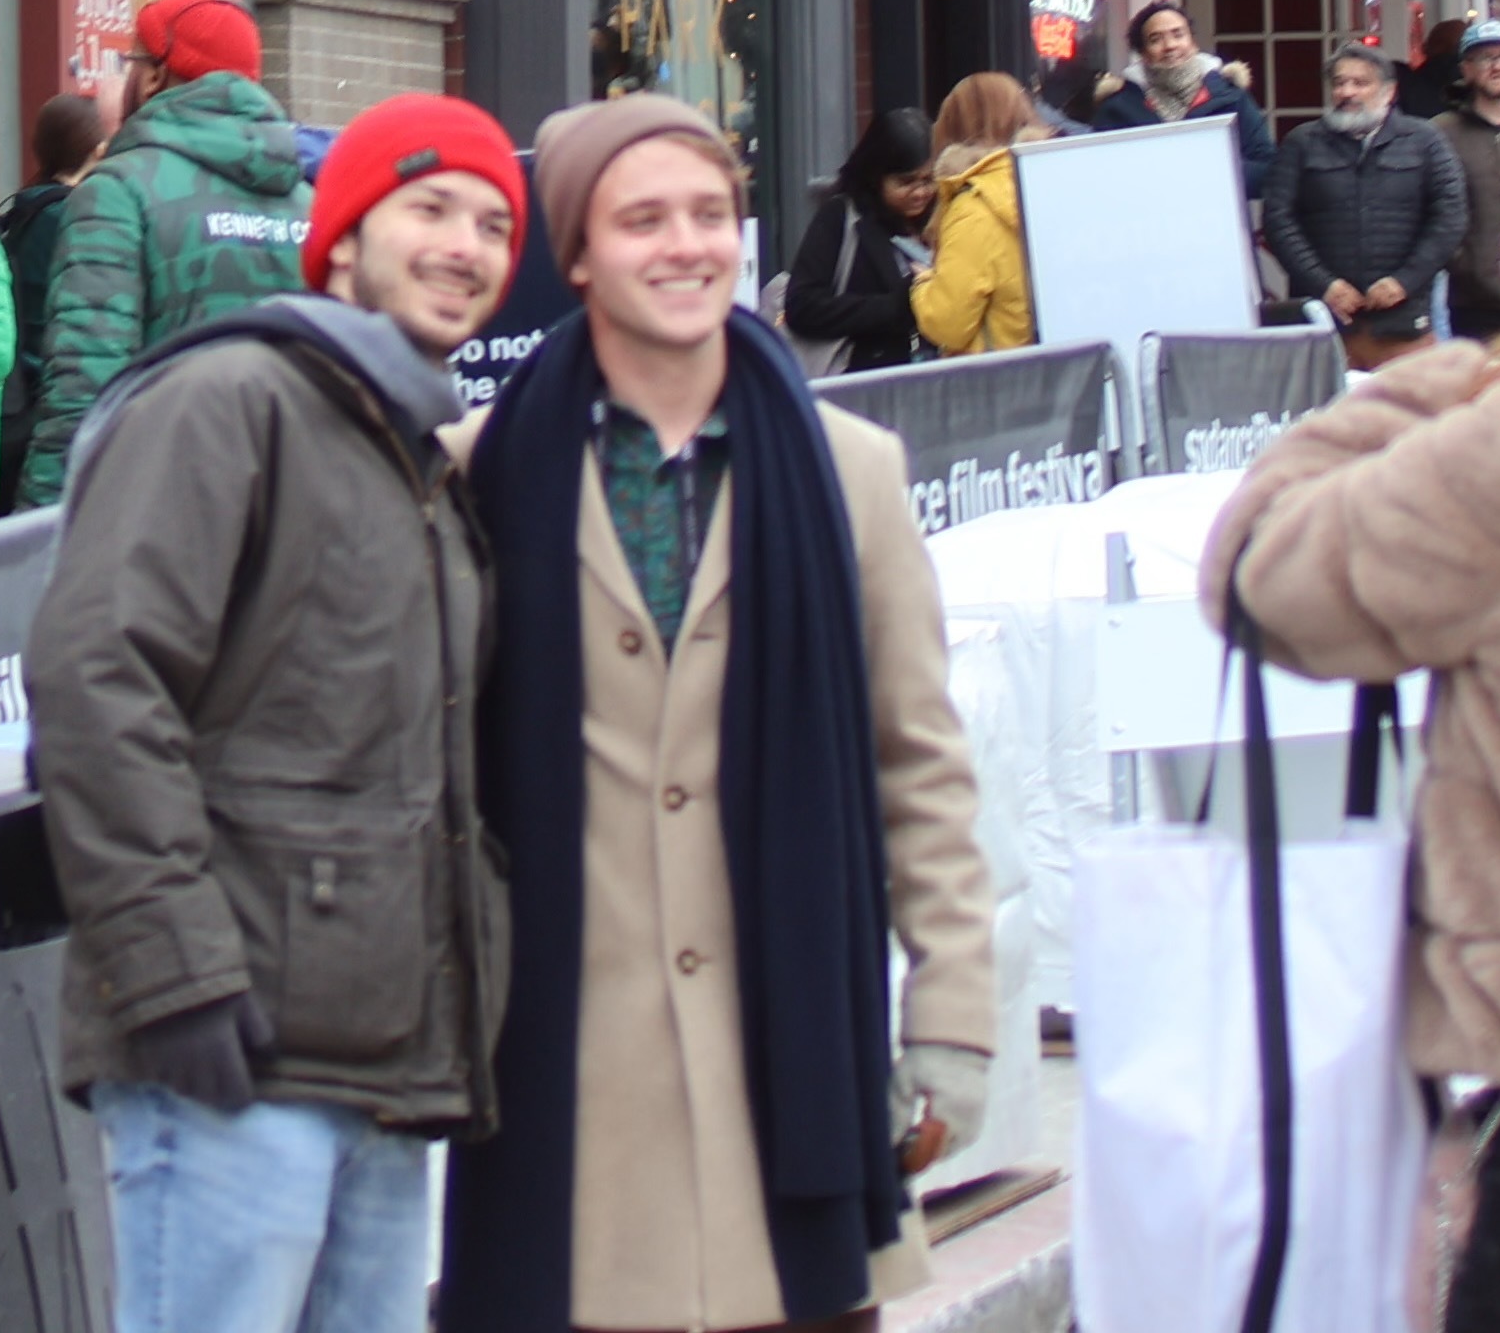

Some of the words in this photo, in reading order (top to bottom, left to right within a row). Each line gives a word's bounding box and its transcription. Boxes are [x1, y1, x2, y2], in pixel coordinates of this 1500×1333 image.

[206, 212, 288, 242] KENNETH
[453, 371, 496, 402] he
[949, 457, 1006, 526] film
